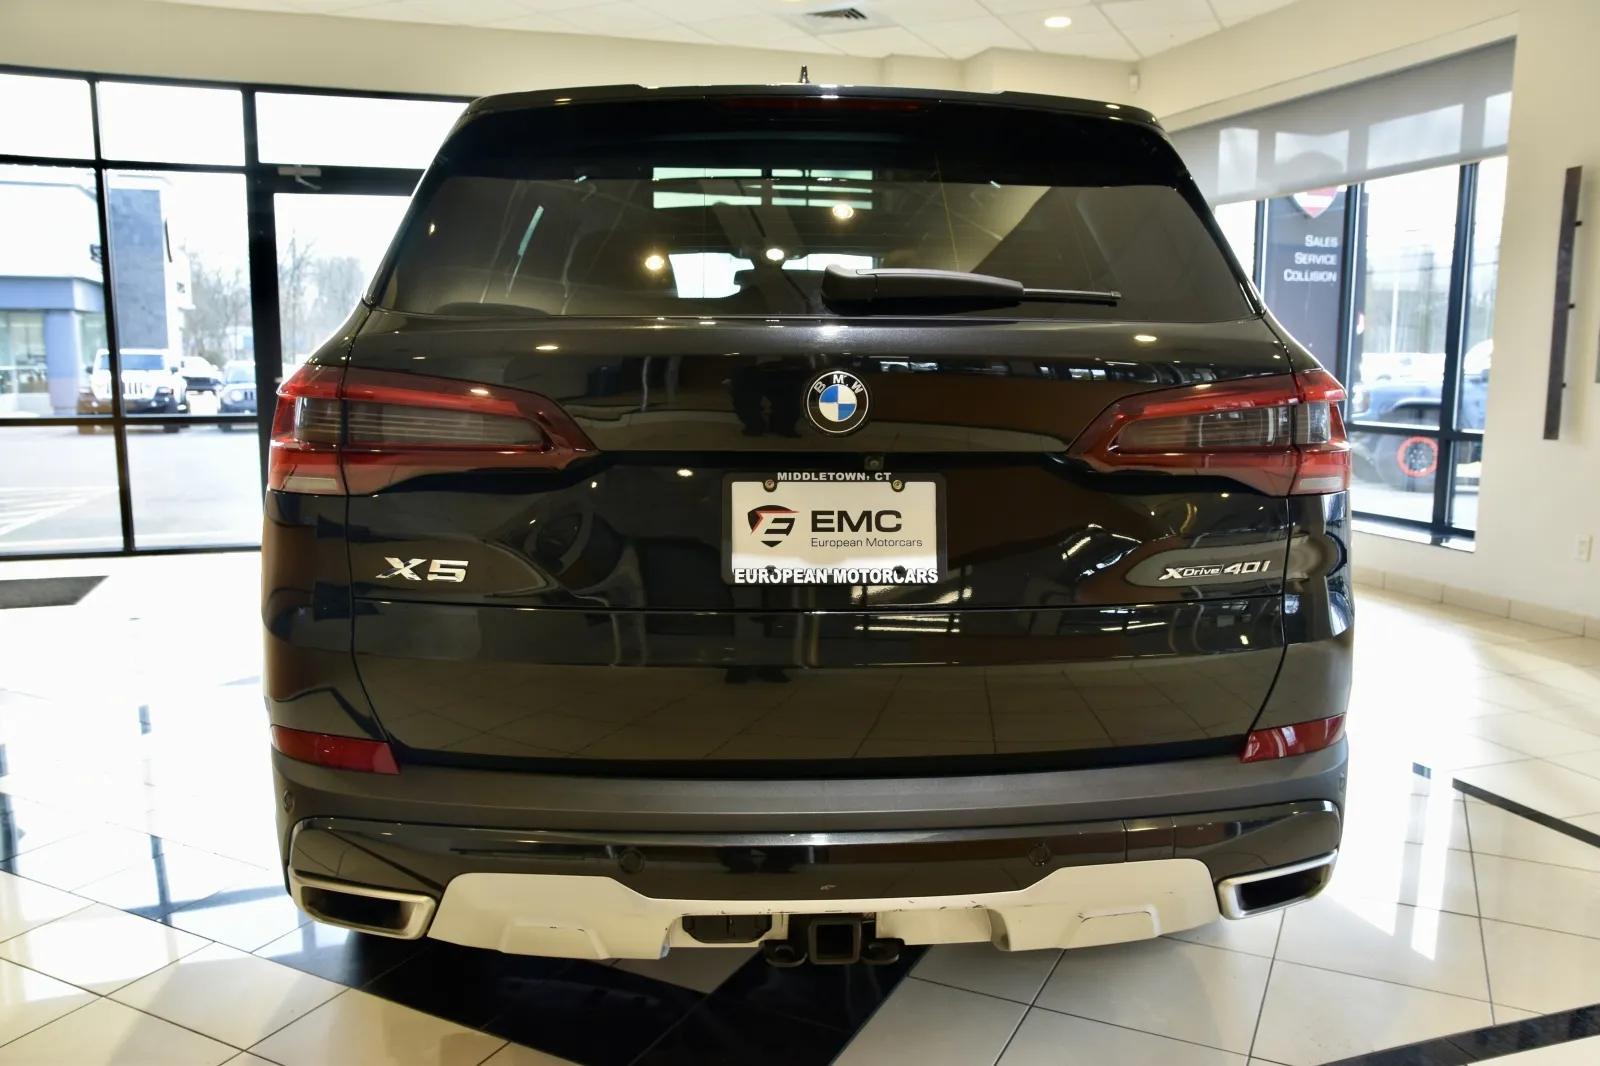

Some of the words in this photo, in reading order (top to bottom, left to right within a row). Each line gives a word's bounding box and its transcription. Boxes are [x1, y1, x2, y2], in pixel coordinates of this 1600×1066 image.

[813, 374, 864, 394] BMW
[777, 472, 870, 481] MIDDLETOWN,
[874, 472, 892, 481] CT
[811, 510, 903, 533] EMC
[811, 537, 863, 549] European
[866, 537, 923, 547] Motorcars
[375, 557, 469, 583] X5
[734, 568, 828, 584] EUROPEAN
[833, 568, 939, 584] MOTORCARS
